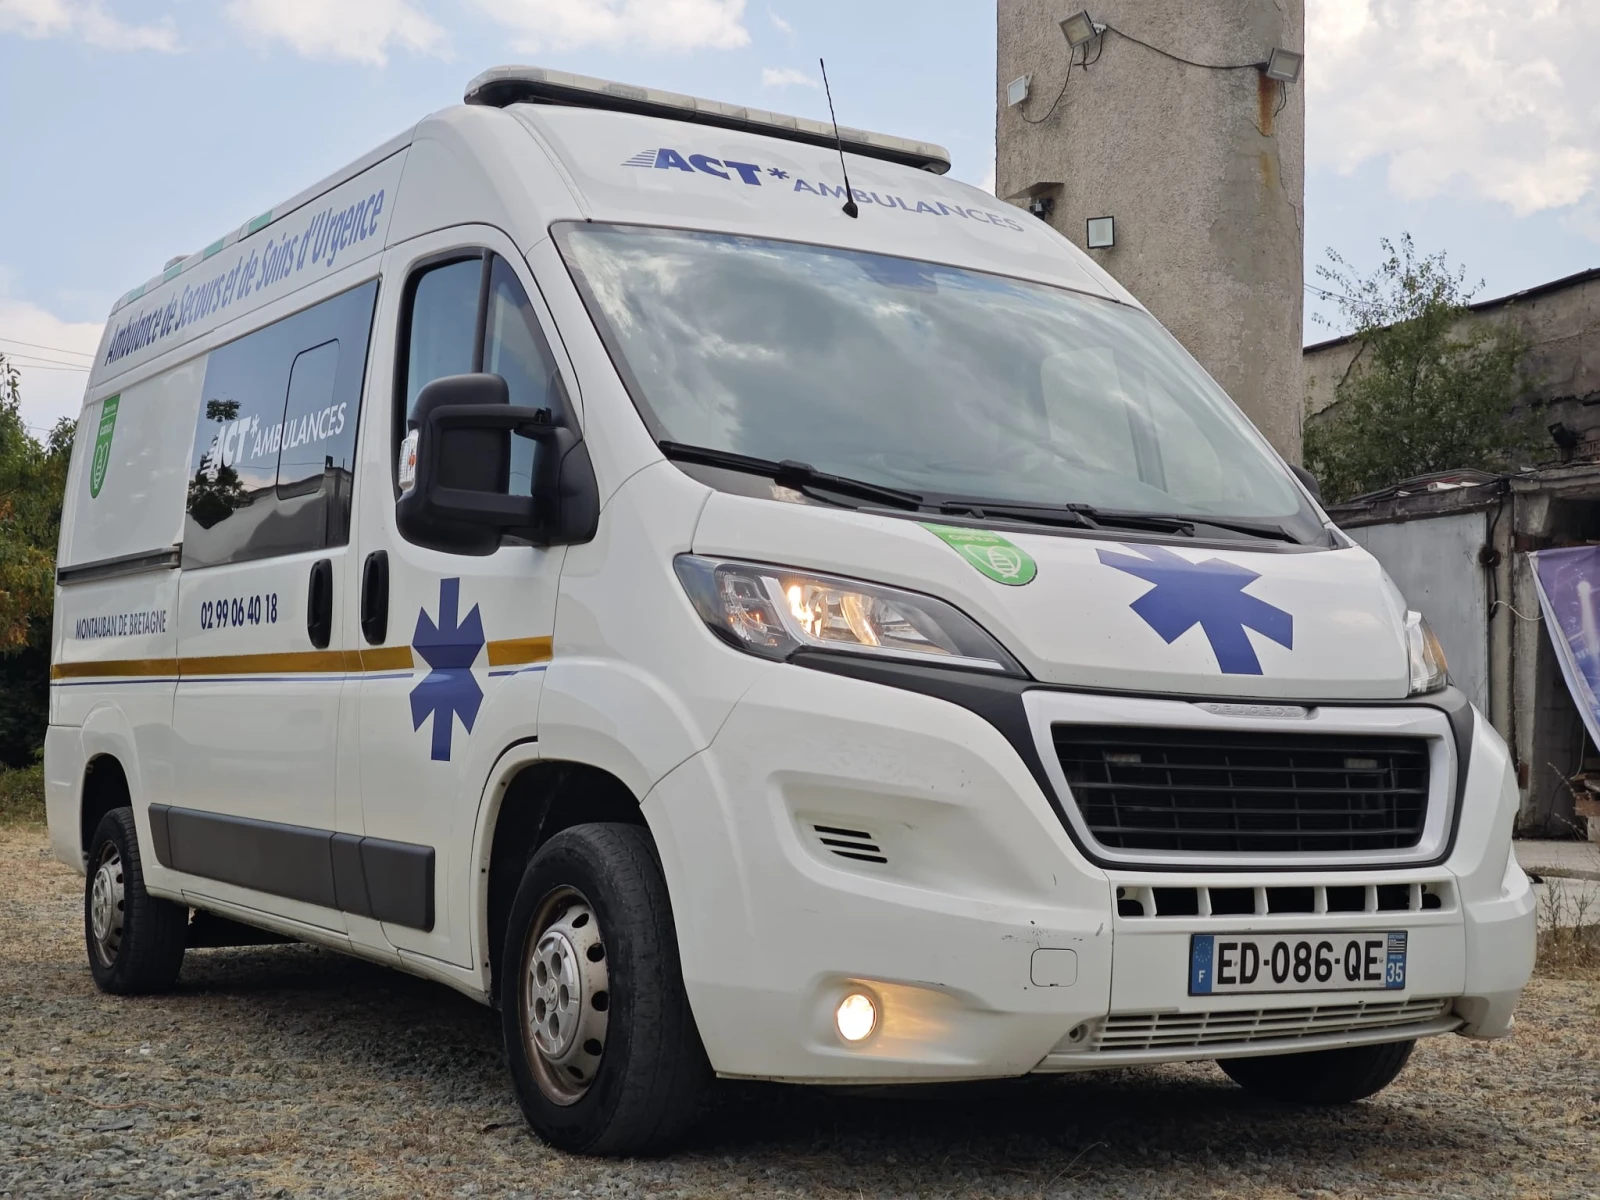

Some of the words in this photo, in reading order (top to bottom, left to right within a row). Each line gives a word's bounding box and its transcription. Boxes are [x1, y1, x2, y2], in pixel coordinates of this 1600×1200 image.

[654, 147, 762, 186] ACT
[794, 178, 1025, 233] AMBULANCES
[103, 307, 163, 367] Ambulance
[159, 292, 178, 340] de
[174, 273, 226, 332] Secours
[221, 256, 243, 308] et
[236, 248, 259, 300] de
[255, 231, 299, 292] Soins
[296, 188, 385, 268] d'Urgence
[210, 416, 252, 473] ACT
[251, 401, 347, 460] AMBULANCES
[75, 614, 117, 640] MONTAUBAN
[118, 613, 127, 636] DE
[129, 610, 167, 636] BRETAGNE
[201, 601, 213, 630] 02
[216, 599, 229, 628] 99
[231, 597, 245, 627] 06
[247, 594, 261, 625] 40
[265, 592, 278, 624] 18
[1209, 704, 1298, 718] PEUGEOT
[1198, 970, 1206, 983] F
[1217, 940, 1384, 985] ED-086-QE
[1387, 962, 1404, 983] 35
